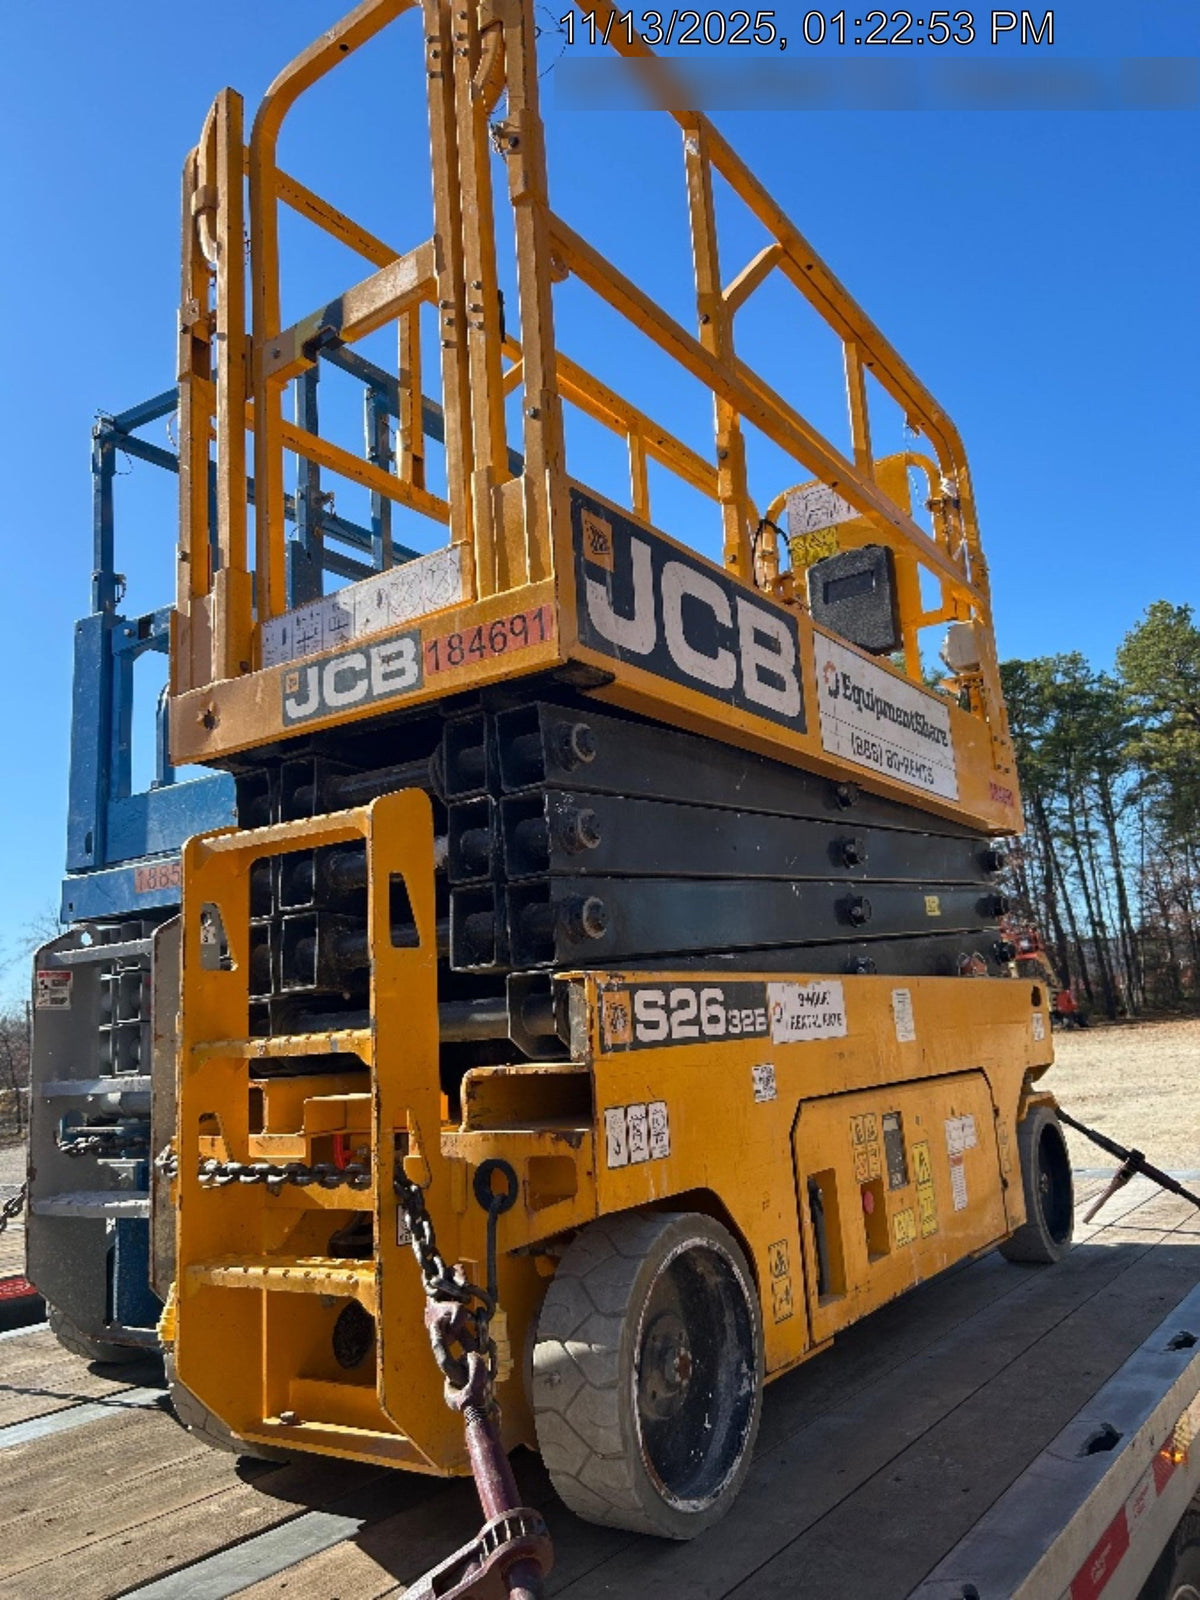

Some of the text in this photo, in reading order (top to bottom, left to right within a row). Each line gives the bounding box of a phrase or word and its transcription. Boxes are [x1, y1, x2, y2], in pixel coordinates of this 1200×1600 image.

[427, 607, 547, 671] 184691
[586, 536, 801, 718] JCB
[286, 637, 419, 720] JCB
[841, 672, 949, 747] EquipmentShare
